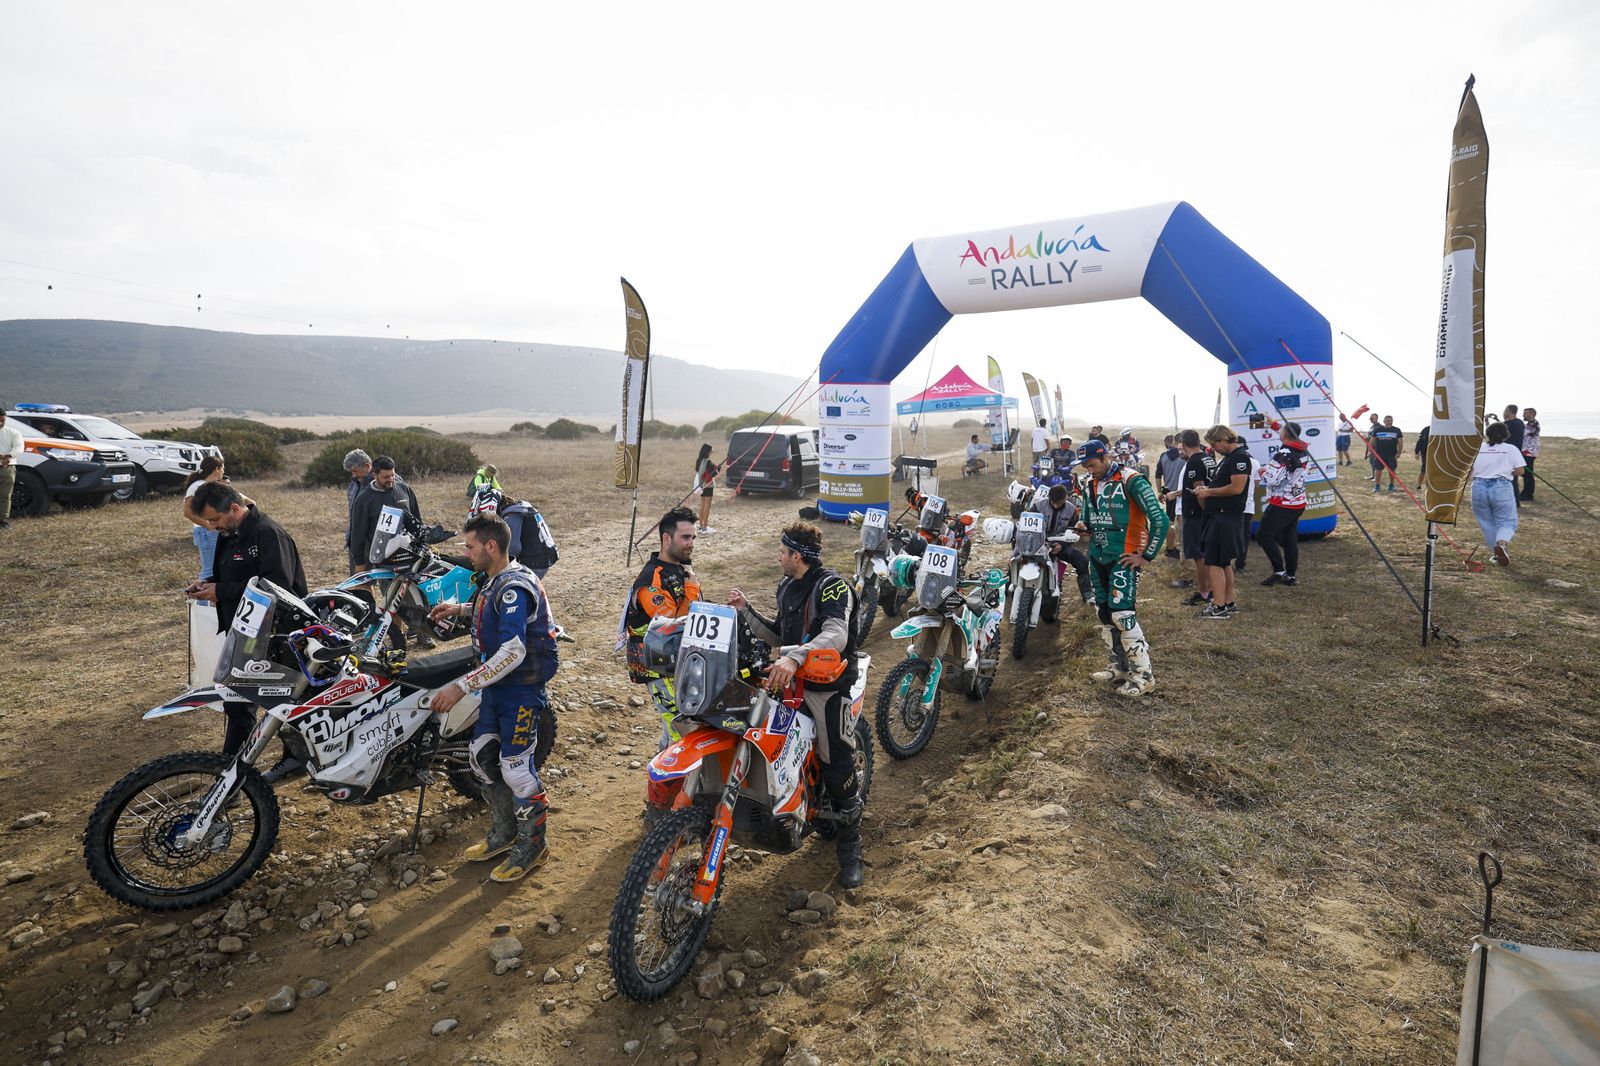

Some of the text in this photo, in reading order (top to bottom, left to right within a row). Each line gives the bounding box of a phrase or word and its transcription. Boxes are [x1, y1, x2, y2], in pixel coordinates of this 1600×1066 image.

[958, 224, 1111, 268] Andalucía
[991, 259, 1078, 290] RALLY
[1439, 264, 1453, 357] CHAMPIONSHIP
[1237, 371, 1331, 397] Andalucía
[1102, 481, 1126, 499] CA
[928, 499, 939, 509] 106
[380, 513, 392, 527] 14
[867, 514, 882, 523] 107
[1024, 517, 1039, 527] 104
[927, 552, 948, 568] 108
[689, 614, 720, 640] 103
[482, 652, 518, 681] RACING
[323, 682, 362, 703] ROUEN
[332, 686, 402, 738] MOVE
[359, 712, 401, 744] smart
[512, 706, 531, 746] FLY
[367, 733, 393, 756] cube
[198, 783, 227, 827] Polisport
[710, 829, 725, 866] MICHELIN
